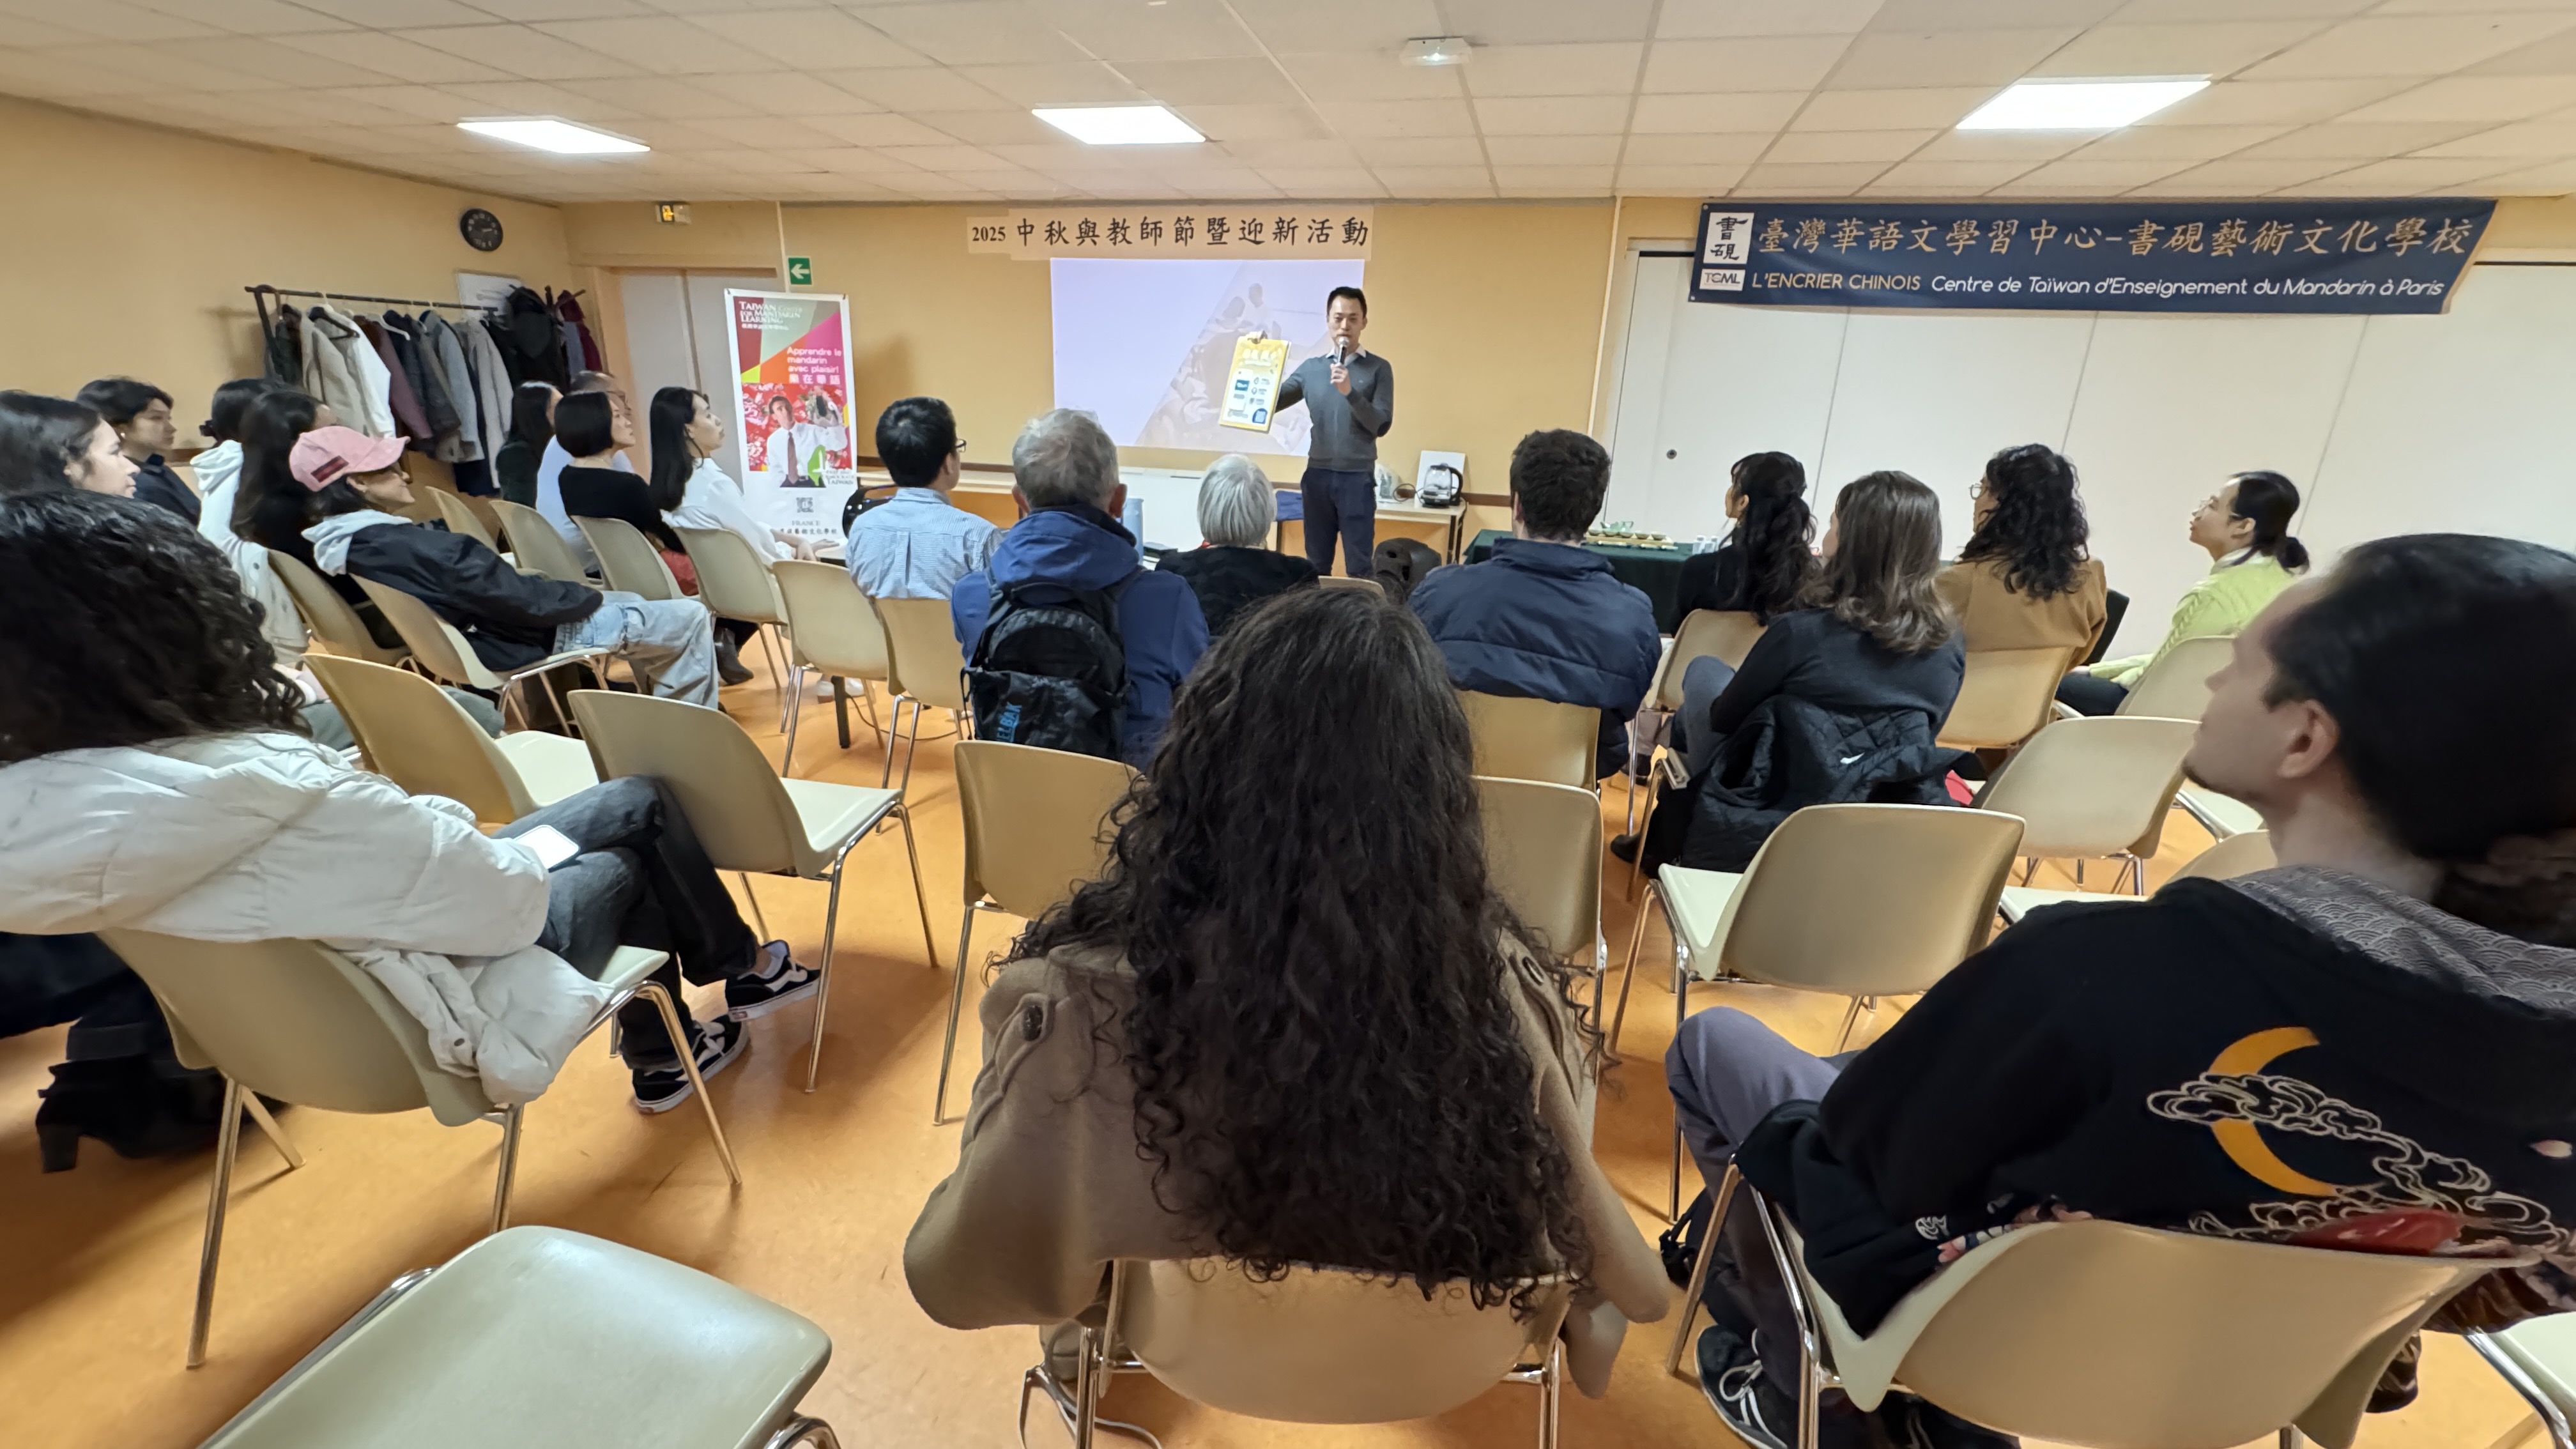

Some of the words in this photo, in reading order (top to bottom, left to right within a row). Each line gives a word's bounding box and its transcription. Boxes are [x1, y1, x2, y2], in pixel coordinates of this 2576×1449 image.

[972, 226, 1006, 242] 2025
[1016, 216, 1368, 247] 中秋與教師節暨迎新活動
[1704, 272, 1740, 284] TCML
[1751, 273, 1843, 289] L'ENCRIER
[1849, 274, 1921, 291] CHINOIS
[1931, 275, 1994, 293] Centre
[1998, 275, 2022, 293] de
[2028, 276, 2089, 294] Taïwan
[2094, 277, 2248, 298] d'Enseignement
[2253, 279, 2280, 295] du
[2282, 279, 2375, 296] Mandarin
[2379, 280, 2393, 296] à
[2396, 280, 2446, 296] Paris
[739, 301, 776, 311] TAIWAN
[786, 346, 832, 356] Apprendre
[834, 348, 842, 356] le
[786, 356, 827, 364] mandarin
